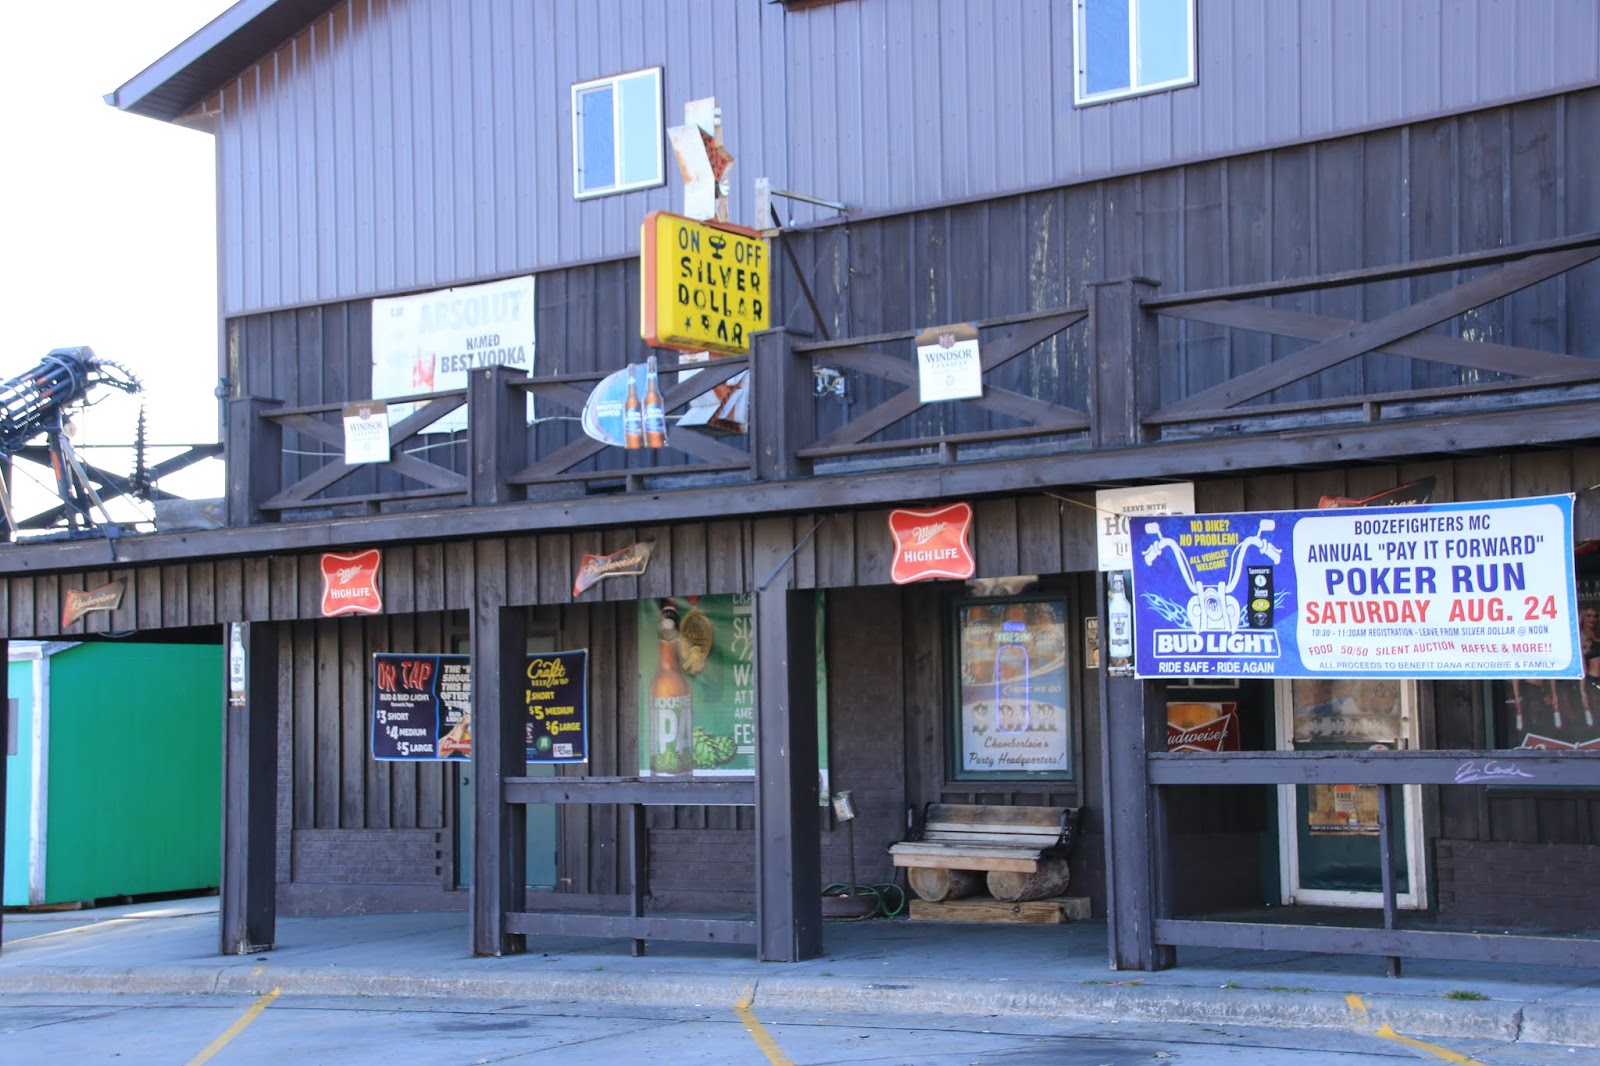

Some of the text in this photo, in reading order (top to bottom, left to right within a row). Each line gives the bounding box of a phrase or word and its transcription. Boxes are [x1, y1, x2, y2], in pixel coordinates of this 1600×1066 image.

[679, 227, 761, 268] ON OFF
[681, 256, 760, 294] SILVER
[678, 284, 762, 321] DOLLAR
[701, 315, 743, 347] BAR
[466, 334, 500, 350] NAMED
[441, 346, 526, 373] BEST VODKA
[926, 348, 972, 363] WINDSOR
[349, 421, 384, 432] WINDSOR
[1122, 503, 1167, 513] SERVE WITH
[1190, 521, 1203, 533] NO
[1205, 519, 1230, 533] BIKE?
[1354, 514, 1491, 535] BOOZEFIGHTERS MC
[912, 521, 949, 545] Miller
[1180, 533, 1239, 546] NO PROBLEM!
[904, 548, 959, 563] HIGH LIFE
[1308, 535, 1544, 563] ANNUAL "PAY IT FORWARD"
[1190, 549, 1229, 565] ALL VEHICLES
[1196, 559, 1227, 572] WELCOME
[1325, 562, 1526, 596] POKER RUN
[331, 587, 371, 599] HIGH LIFE
[1306, 595, 1558, 625] SATURDAY AUG. 24
[1312, 629, 1331, 637] 10:30
[1338, 629, 1367, 637] 11:30AM
[1368, 628, 1414, 637] REGISTRATION
[1419, 628, 1439, 636] LEAVE
[1440, 627, 1460, 636] FROM
[1462, 627, 1485, 636] SILVER
[1487, 627, 1515, 635] DOLLAR
[1528, 625, 1549, 635] NOON
[1158, 634, 1275, 653] BUD LIGHT
[1308, 641, 1552, 657] FOOD 50/50 SILENT AUCTION RAFFLE & MORE!!
[444, 665, 461, 673] THE
[527, 658, 566, 687] Craft
[1159, 662, 1181, 673] RIDE
[1183, 662, 1209, 673] SAFE
[1217, 662, 1241, 673] RIDE
[1242, 662, 1275, 673] AGAIN
[1465, 661, 1512, 669] KENOBBIE
[1523, 661, 1555, 669] FAMILY
[377, 660, 432, 692] ON TAP
[442, 673, 471, 682] SHOUL
[441, 683, 461, 691] THIS
[410, 693, 430, 701] LIGHT
[532, 691, 555, 700] SHORT
[376, 709, 409, 724] $3 SHORT
[529, 705, 545, 720] $5
[386, 725, 427, 740] $4 MEDIUM
[546, 721, 581, 735] $6 LARGE
[1168, 728, 1228, 745] udweiser
[397, 742, 410, 756] $5
[410, 744, 434, 752] LARGE
[969, 752, 994, 767] Party
